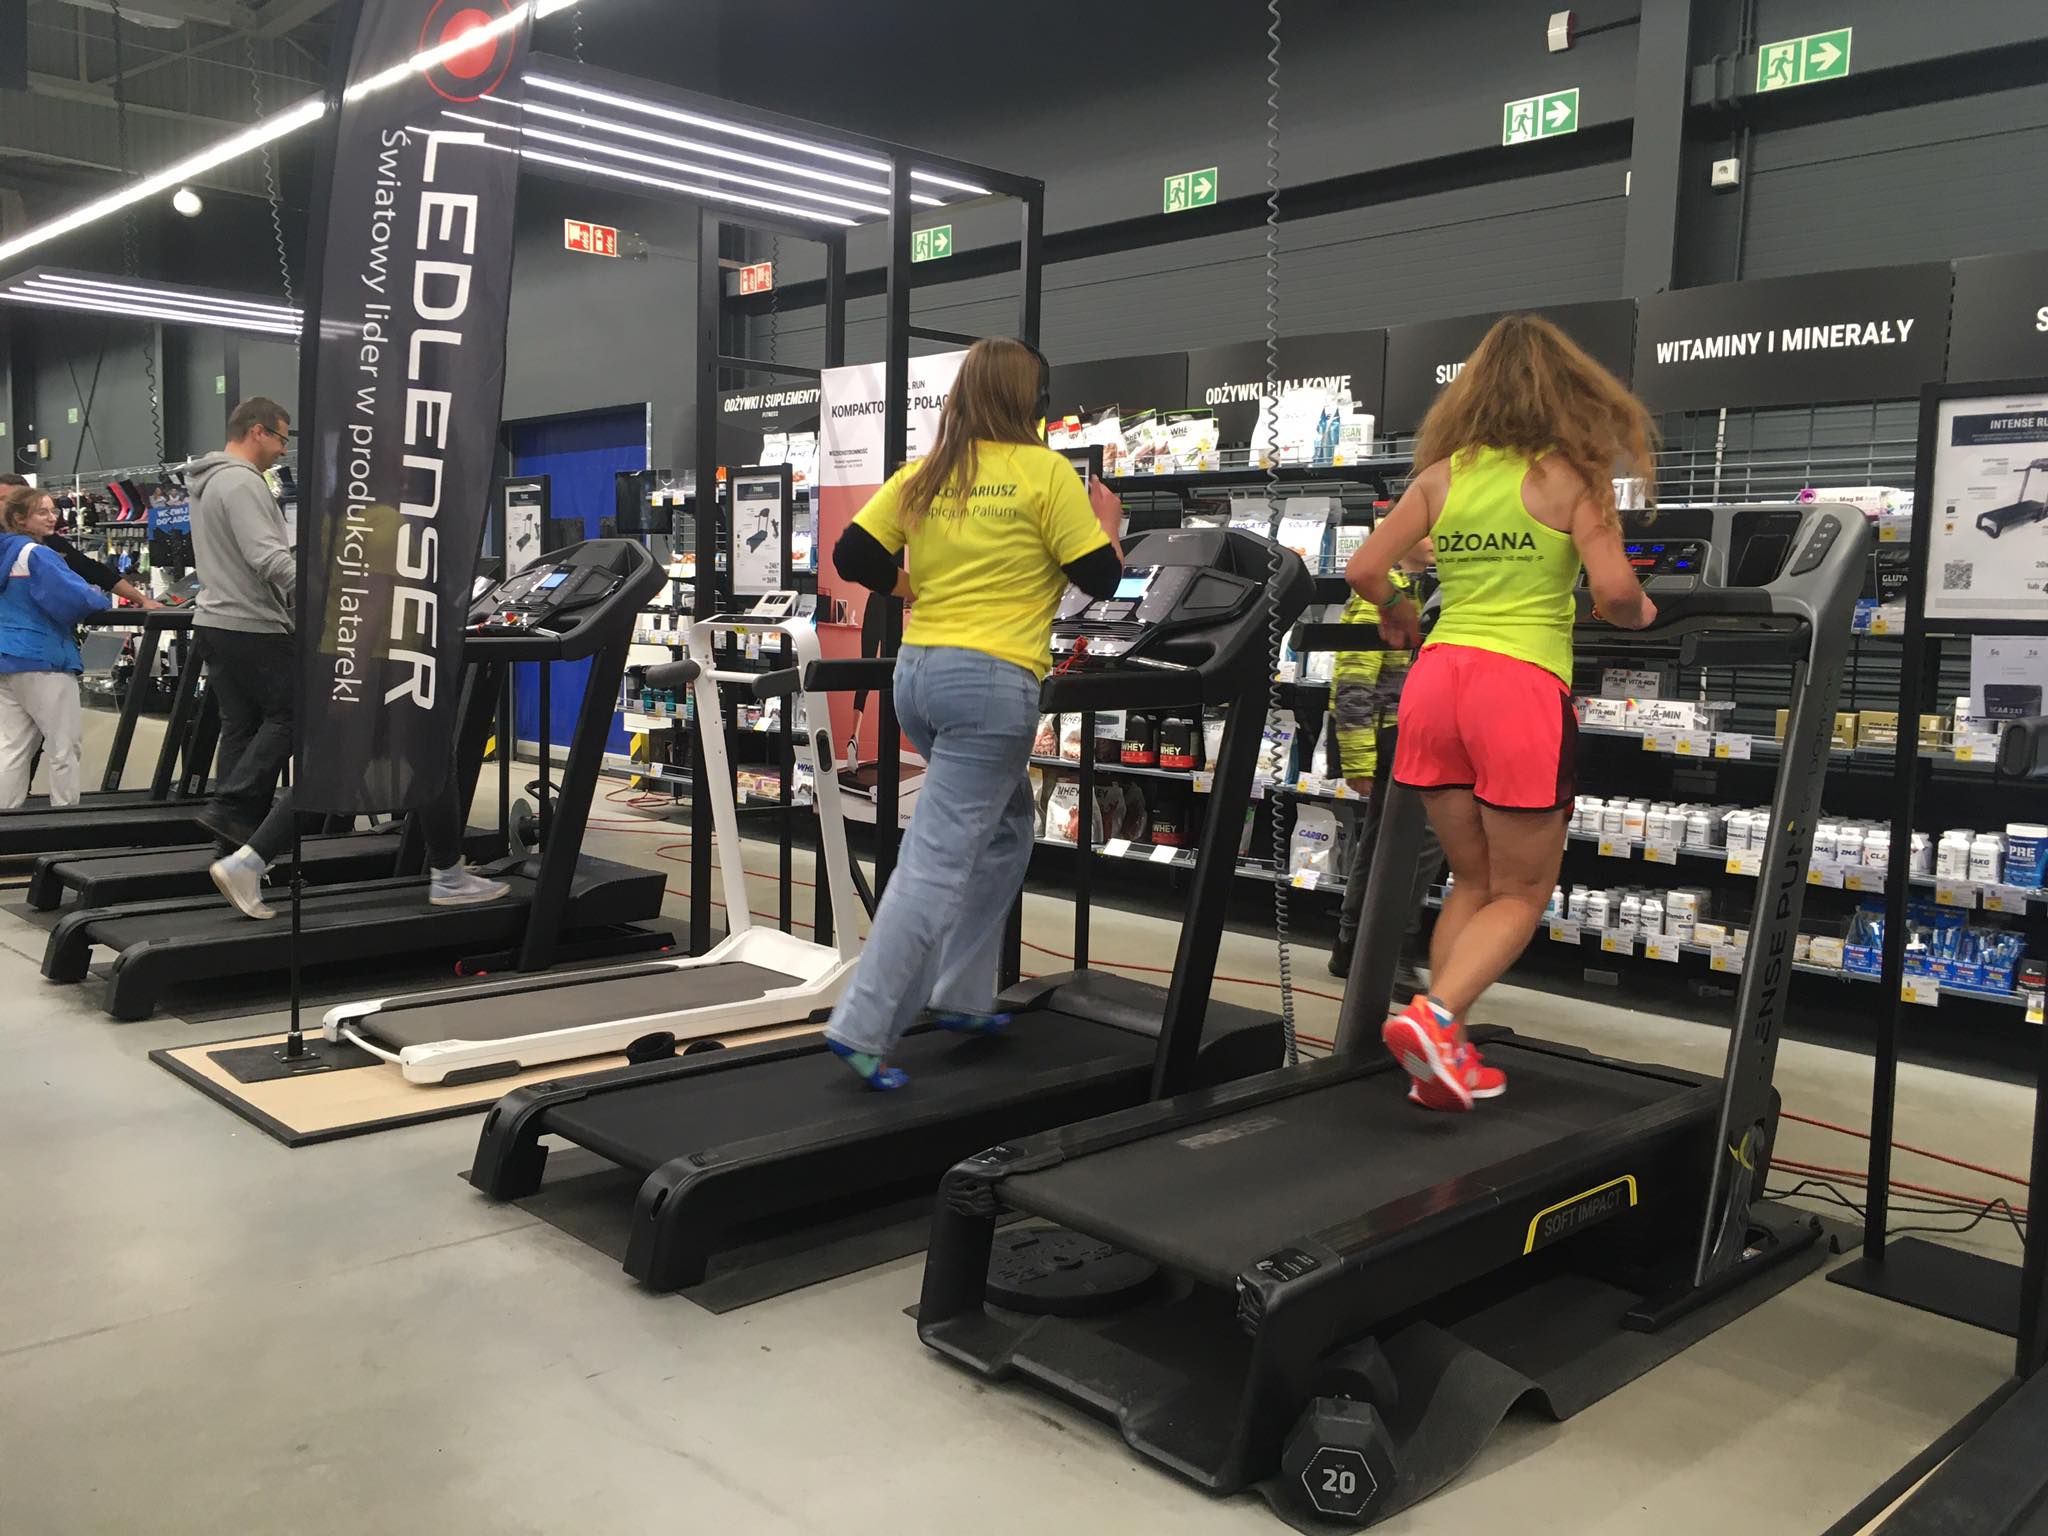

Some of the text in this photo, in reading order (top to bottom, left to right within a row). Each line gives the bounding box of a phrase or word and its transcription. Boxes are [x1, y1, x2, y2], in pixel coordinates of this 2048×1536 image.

[1656, 318, 1915, 364] WITAMINY I MINERAŁY
[912, 380, 925, 390] RUN
[1205, 381, 1263, 405] ODŻYWKI
[723, 394, 760, 412] ODŻYWKI
[764, 388, 821, 408] SUPLEMENTY
[831, 400, 886, 418] KOMPAKTO
[332, 129, 411, 703] Światowy lider w produkcji latarek!
[1990, 417, 2034, 430] INTENSE
[1170, 425, 1188, 437] WHE
[972, 503, 1017, 518] Palium
[1437, 530, 1536, 553] DŻOANA
[1121, 742, 1145, 752] WHEY
[1160, 746, 1182, 756] WHEY
[797, 762, 814, 773] WHE
[1057, 783, 1080, 797] WHEY
[1152, 823, 1177, 833] WHEY
[1298, 829, 1329, 842] CARBO
[1840, 849, 1858, 857] ZMA
[2009, 845, 2037, 858] PRE
[1544, 1187, 1624, 1237] SOFT IMPACT
[1322, 1468, 1356, 1494] 20
